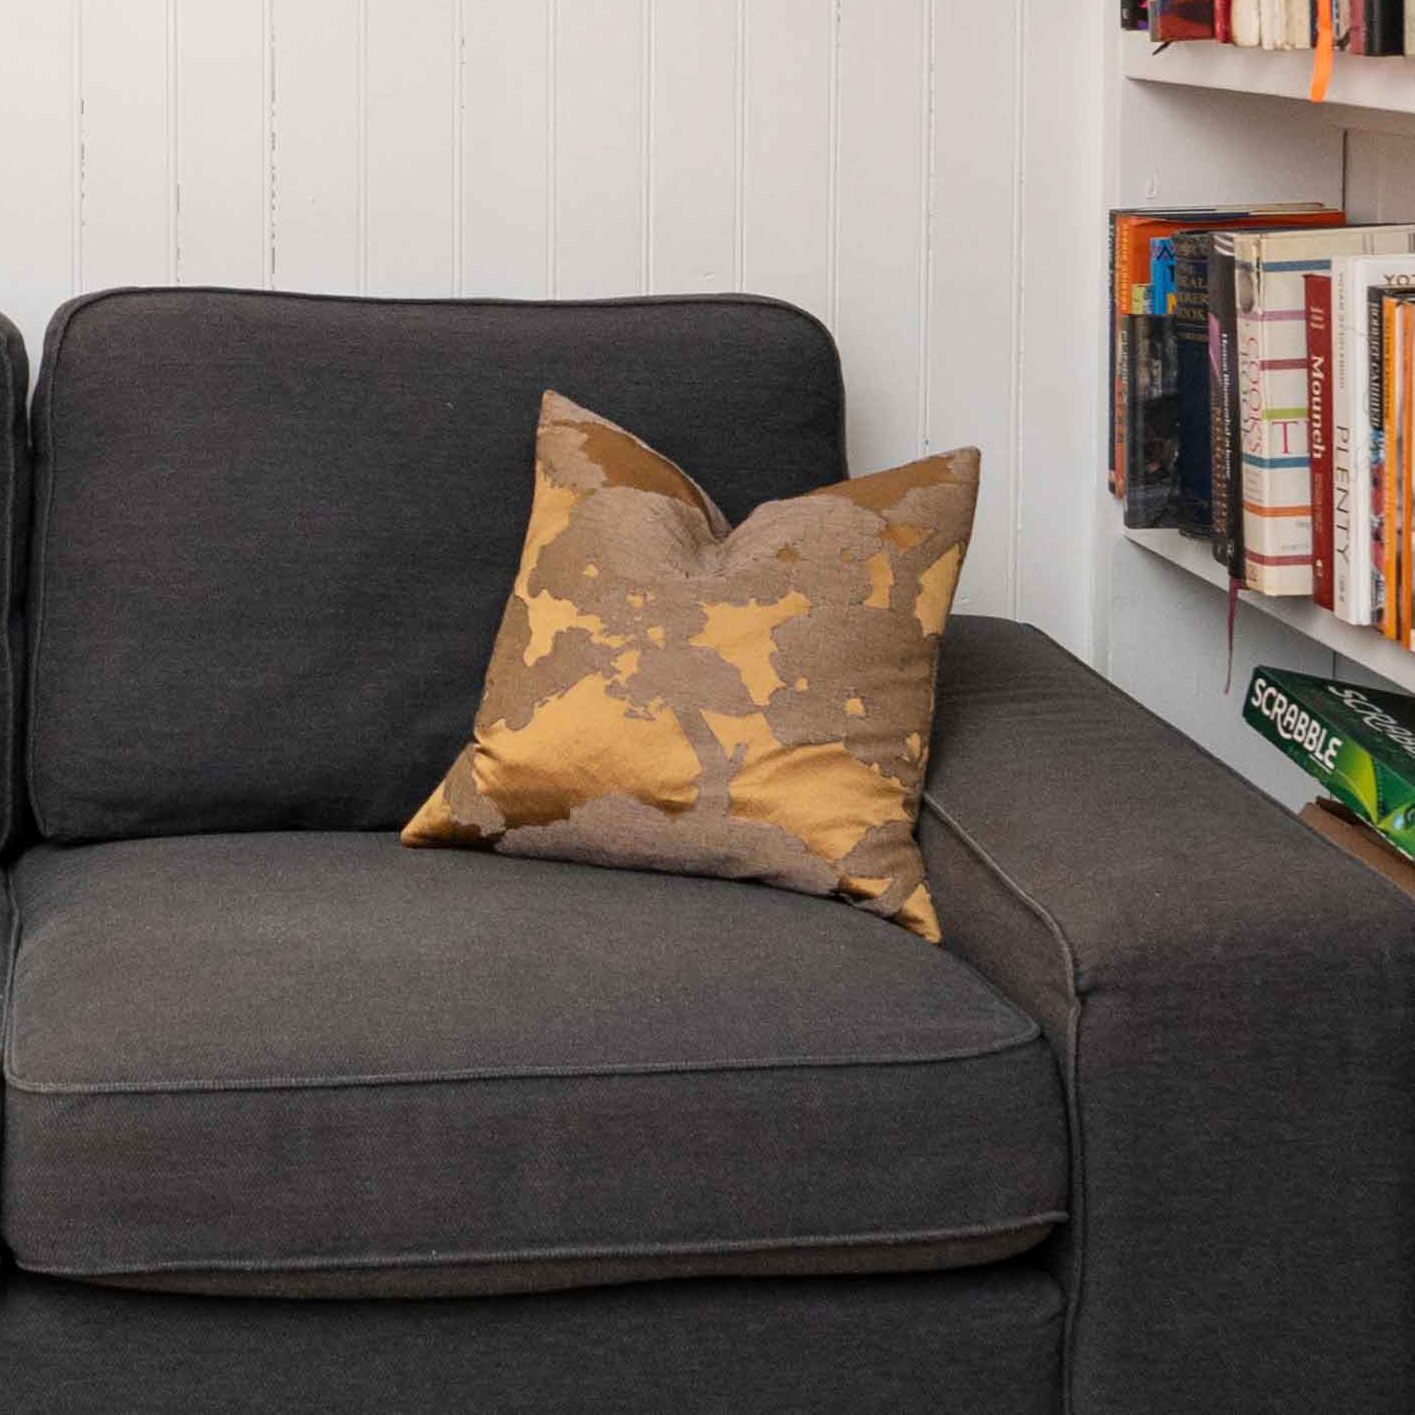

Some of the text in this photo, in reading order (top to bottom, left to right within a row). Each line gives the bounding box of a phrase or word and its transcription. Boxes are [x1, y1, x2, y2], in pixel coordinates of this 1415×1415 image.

[1384, 273, 1415, 287] YO
[1311, 354, 1326, 459] Mouneh
[1335, 425, 1351, 564] PLENTY
[1250, 678, 1343, 770] SCRABBLE
